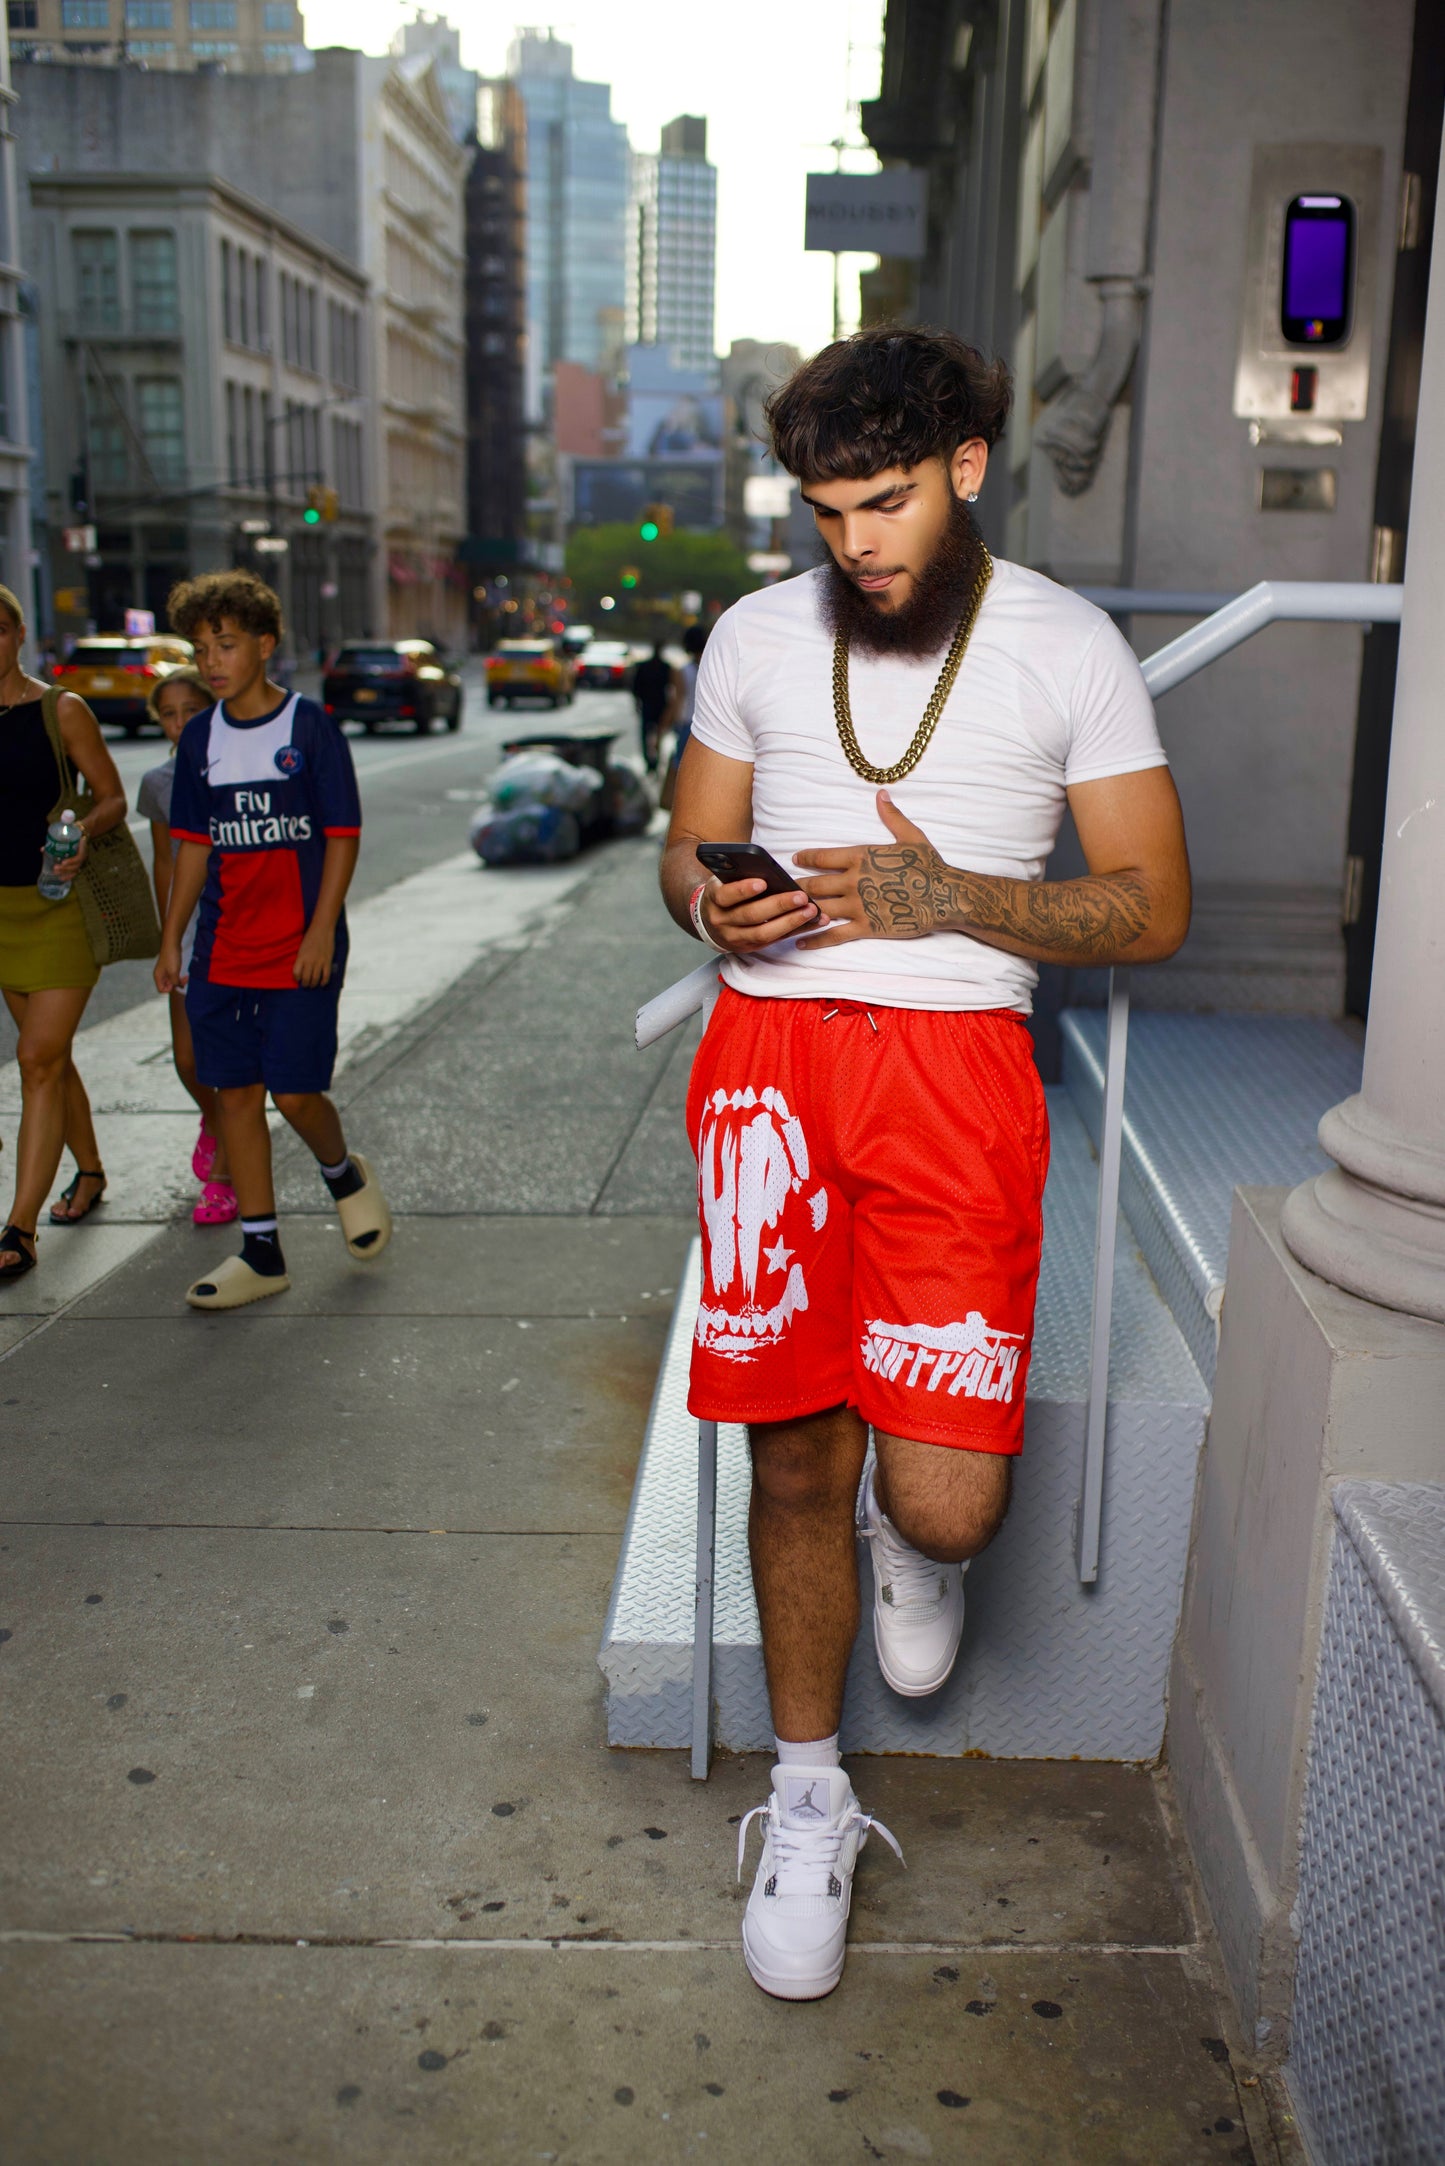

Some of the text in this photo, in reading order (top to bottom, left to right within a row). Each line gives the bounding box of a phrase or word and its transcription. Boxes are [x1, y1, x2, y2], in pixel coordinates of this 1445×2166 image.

[234, 790, 271, 815] Fly
[209, 814, 312, 847] Emirates
[934, 884, 956, 919] The
